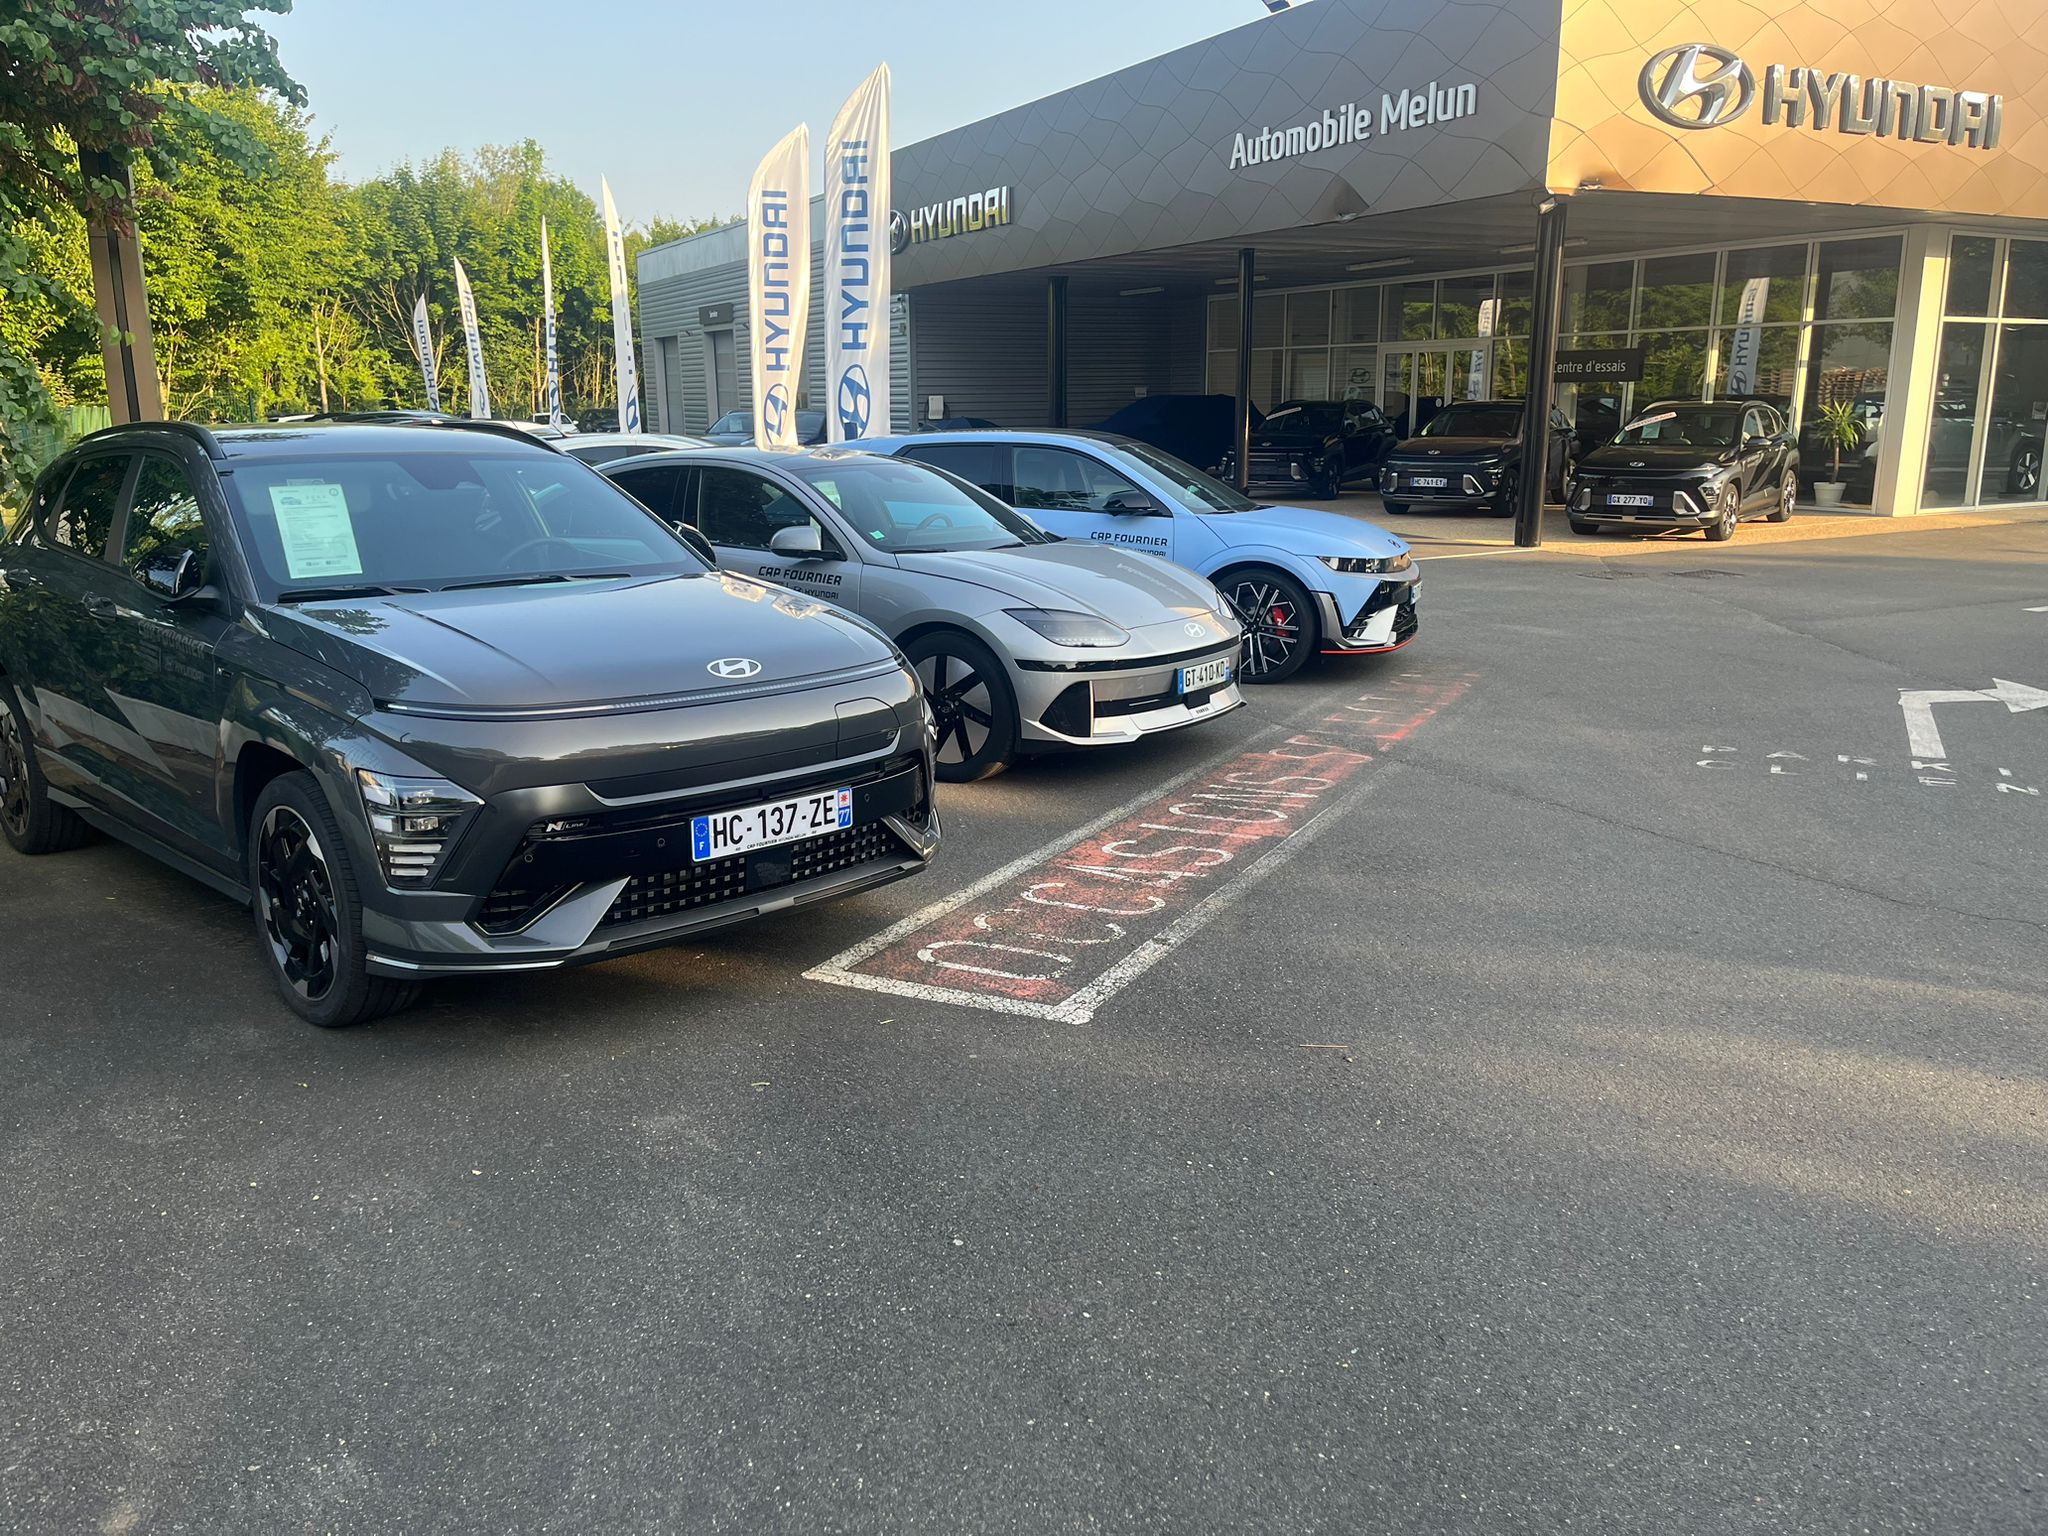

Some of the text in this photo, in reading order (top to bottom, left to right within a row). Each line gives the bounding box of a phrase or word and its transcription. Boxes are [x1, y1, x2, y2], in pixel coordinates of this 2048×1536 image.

[1230, 81, 1477, 170] Automobile Melun
[1763, 63, 2004, 150] HYUNDAI
[910, 186, 1013, 244] HYUNDAI
[841, 140, 869, 351] HYUNDAI
[761, 190, 790, 371] HYUNDAI
[1585, 359, 1626, 373] d'essais
[1090, 531, 1169, 547] CAP FOURNIER
[758, 566, 782, 578] CAP
[783, 568, 842, 586] FOURNIER
[712, 794, 836, 850] HC-137-ZE
[839, 808, 850, 824] 77
[699, 841, 705, 851] F
[915, 771, 1337, 982] OCCASIONS
